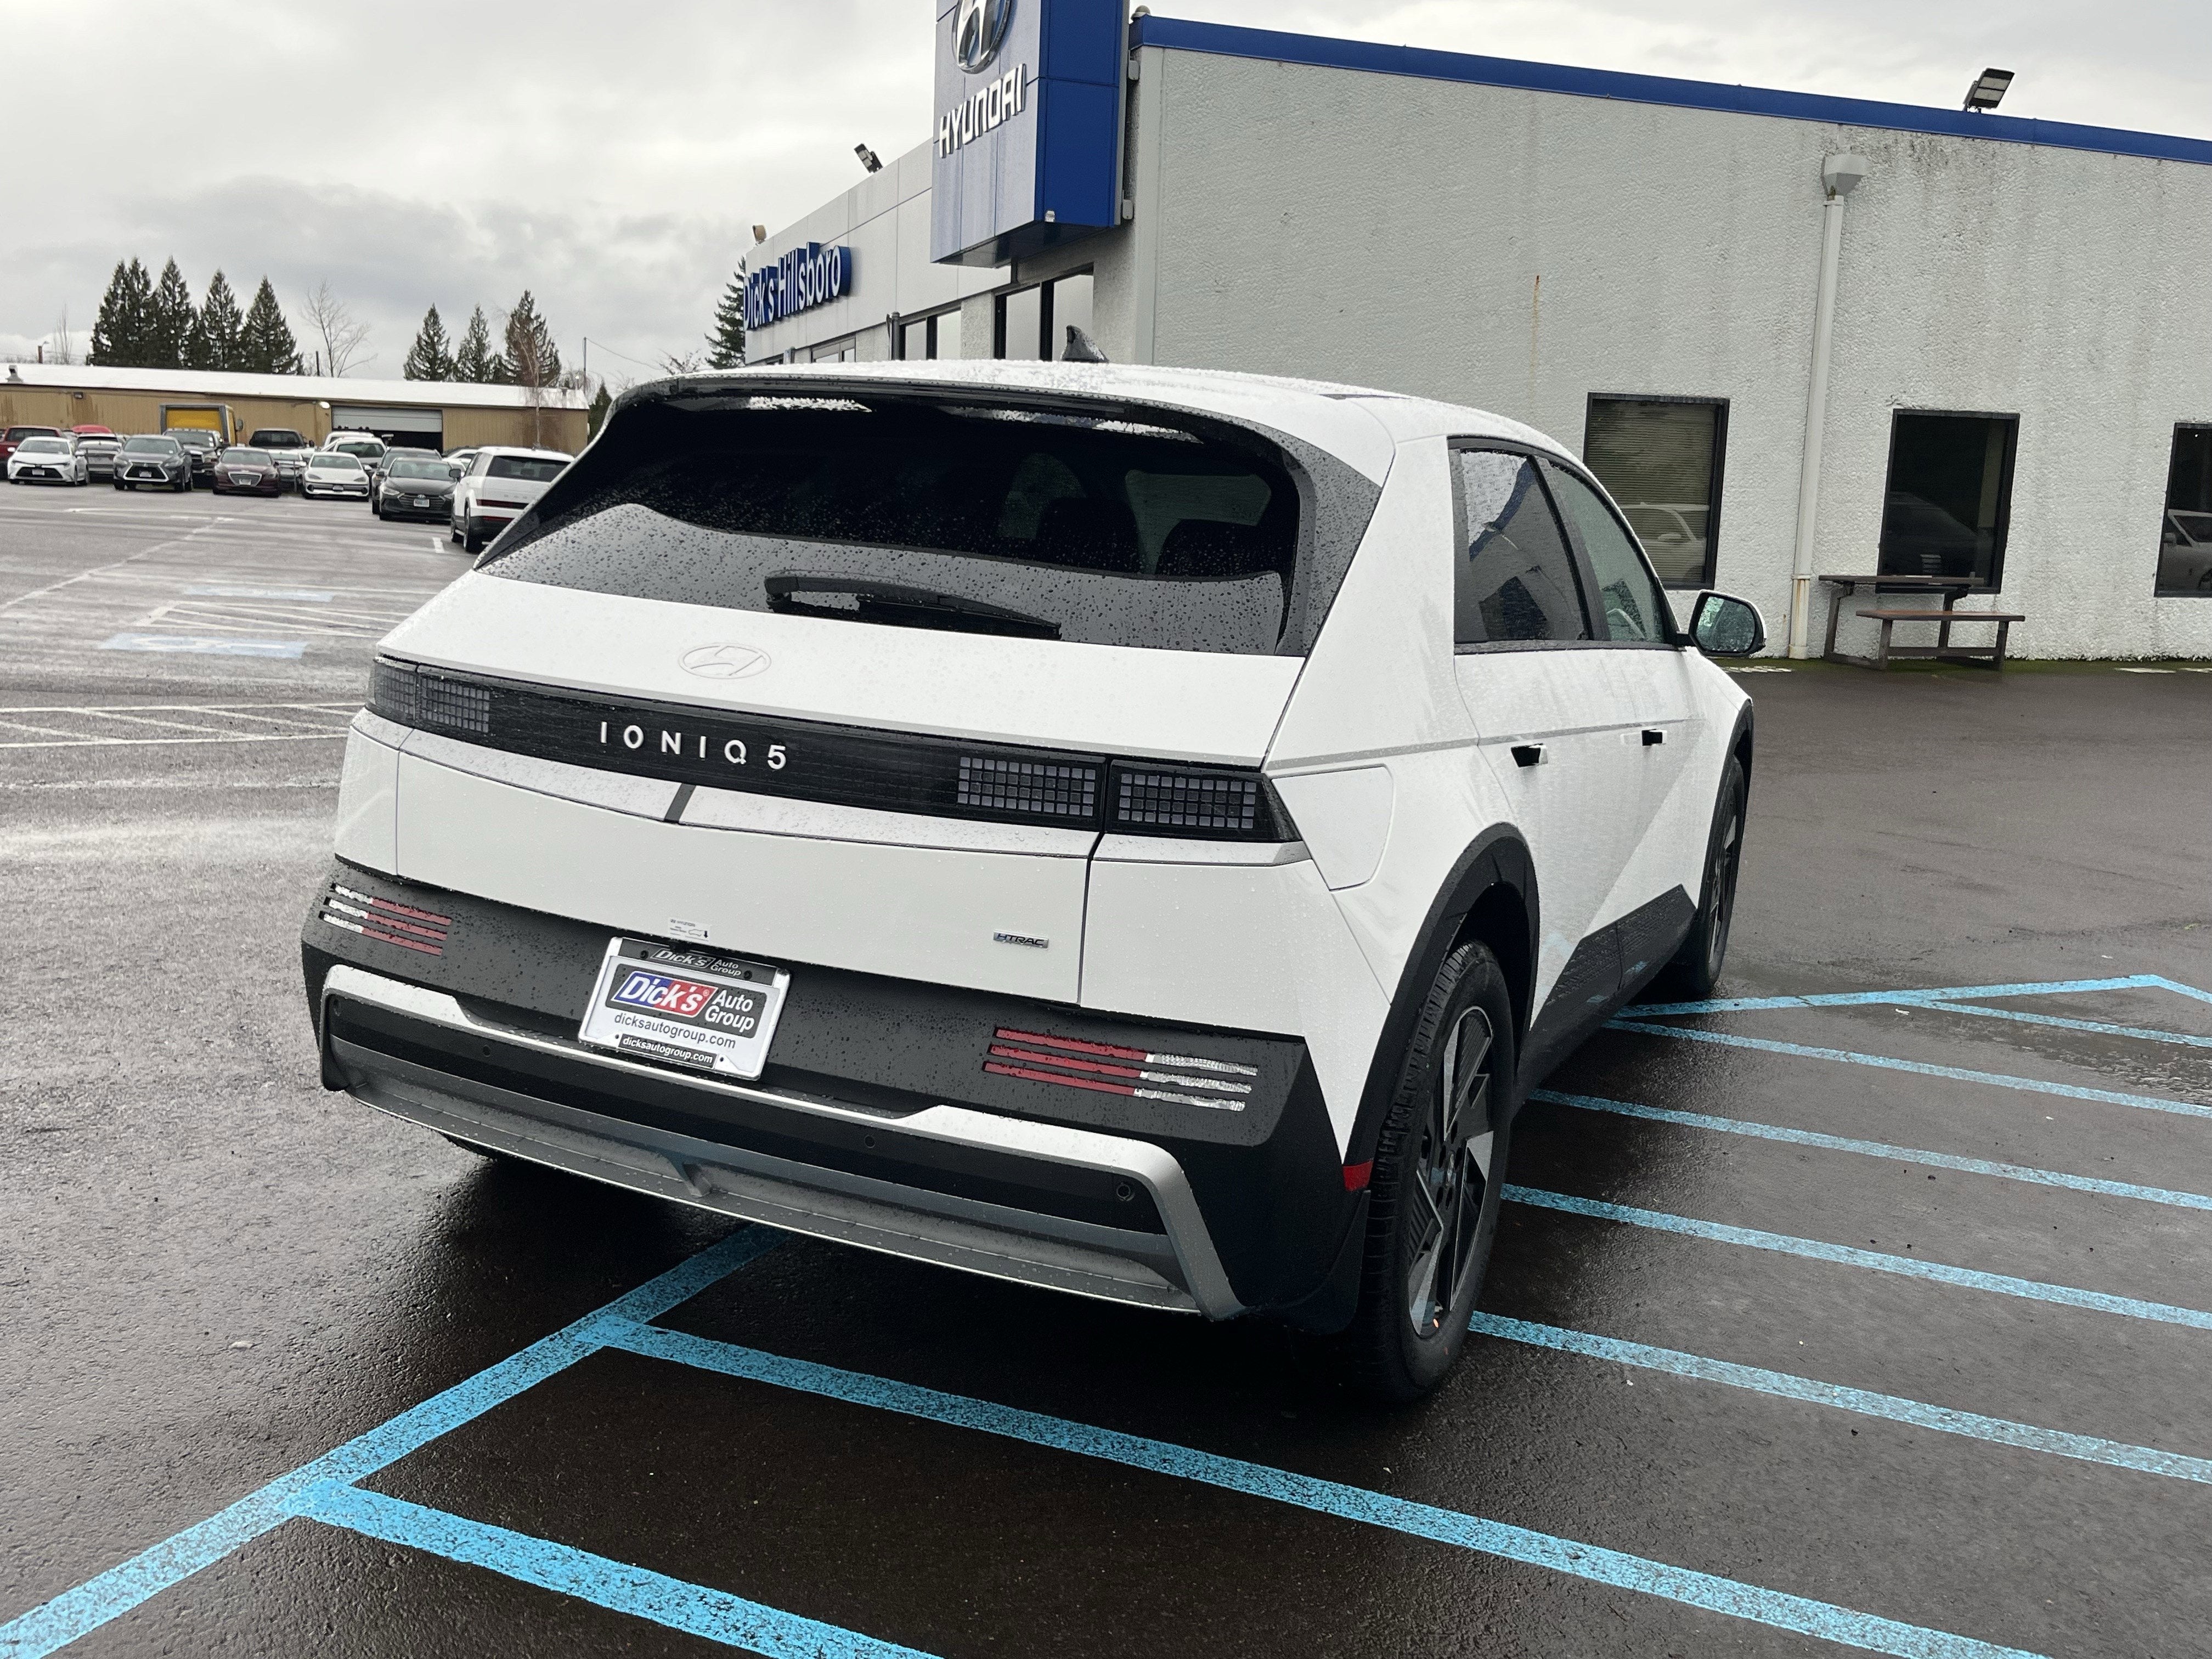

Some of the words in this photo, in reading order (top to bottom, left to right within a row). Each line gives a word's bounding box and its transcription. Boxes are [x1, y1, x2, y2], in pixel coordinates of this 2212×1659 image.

[939, 63, 1027, 159] HYUNDAI
[743, 266, 774, 331] Dick's
[777, 241, 843, 318] Hillsboro
[600, 721, 747, 765] IONIQ
[767, 744, 787, 770] 5
[996, 933, 1045, 946] HTRAC
[655, 950, 708, 967] Dick's
[714, 959, 740, 969] Auto
[710, 964, 742, 977] Group
[619, 977, 703, 1012] Dick's
[712, 990, 753, 1013] Auto
[614, 1013, 736, 1049] dicksautogroup.com
[705, 1005, 755, 1033] Group
[622, 1036, 713, 1064] dicksautogroup.com
